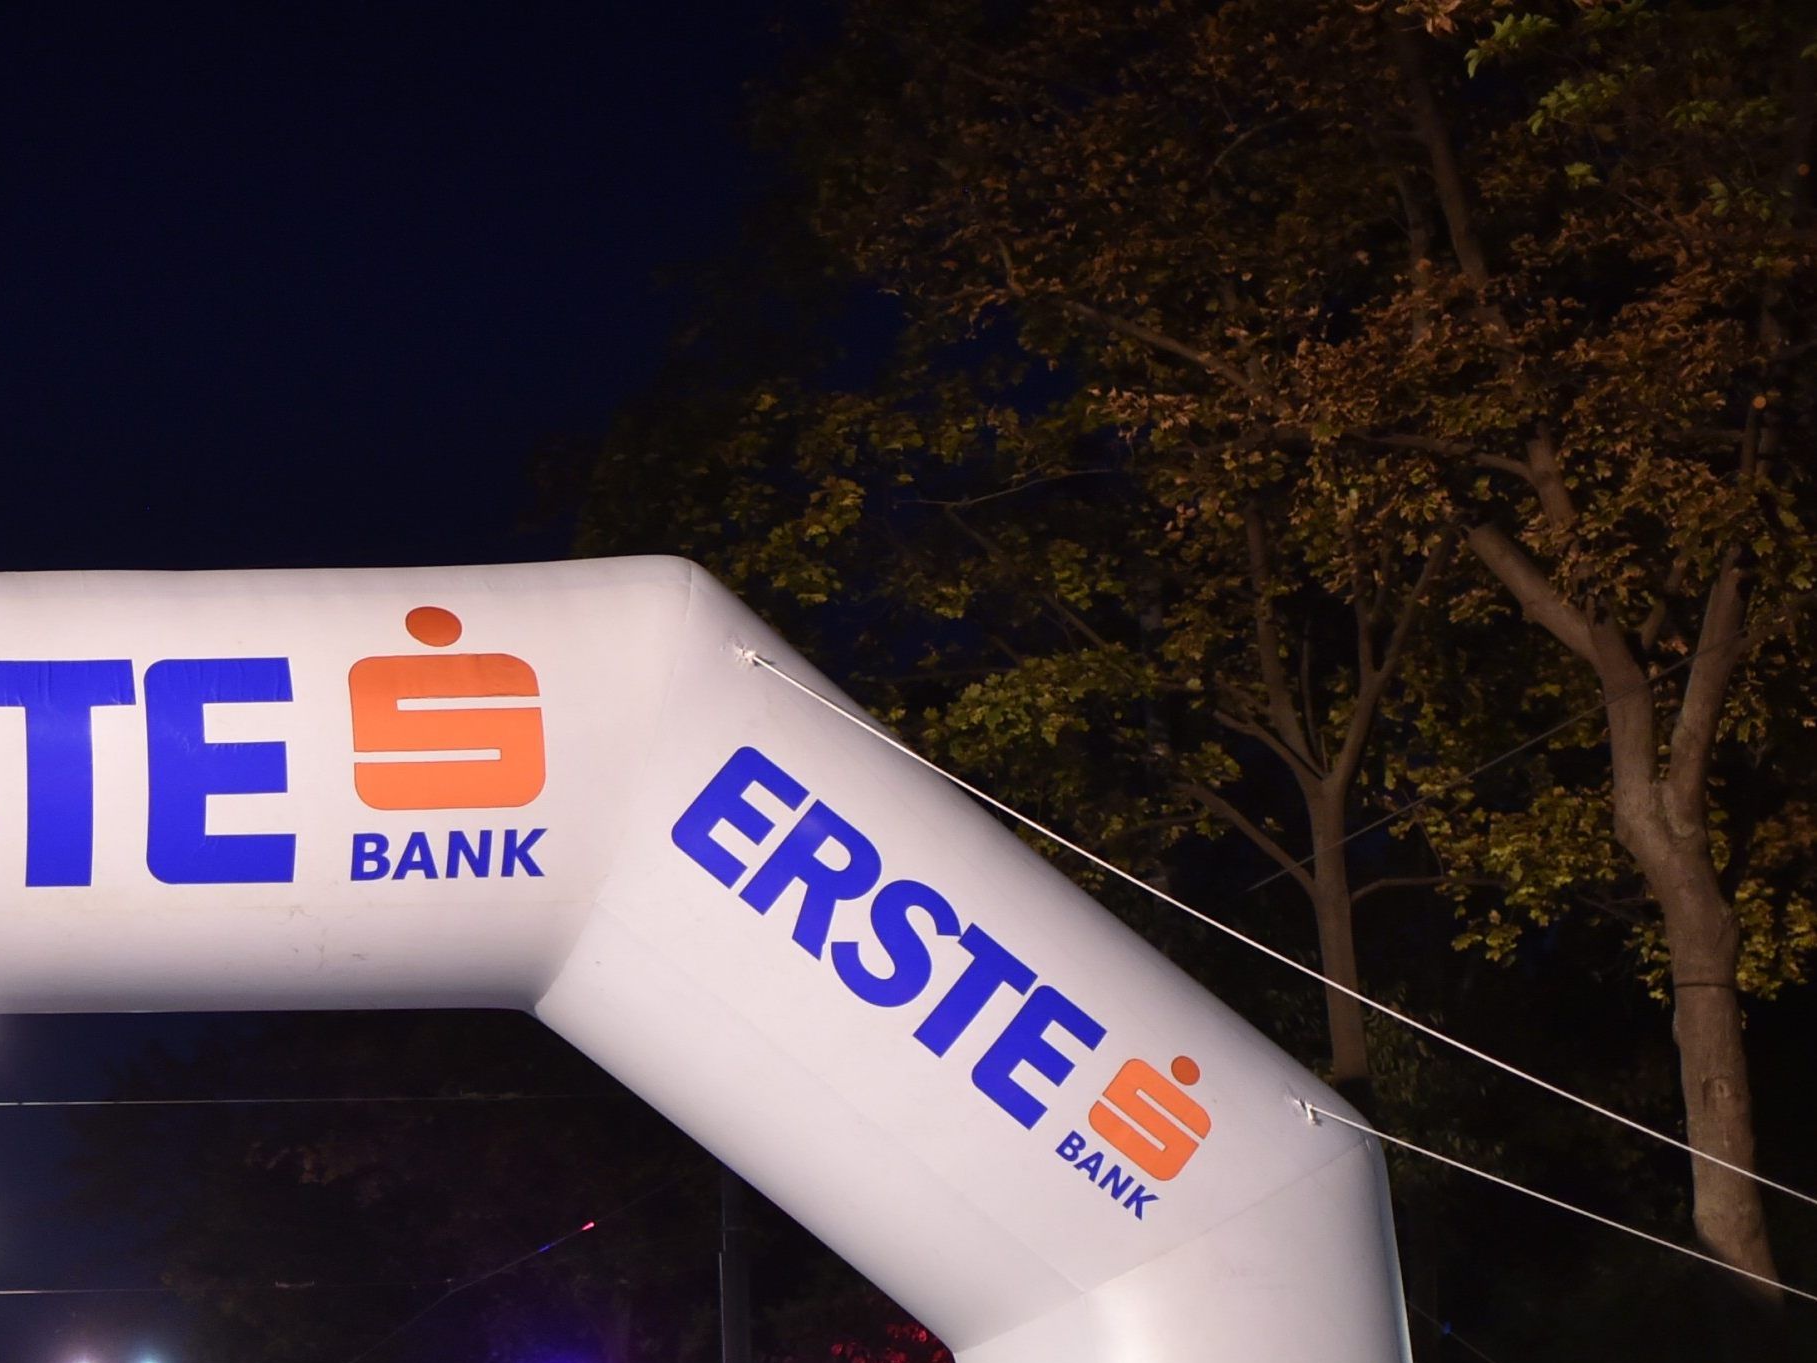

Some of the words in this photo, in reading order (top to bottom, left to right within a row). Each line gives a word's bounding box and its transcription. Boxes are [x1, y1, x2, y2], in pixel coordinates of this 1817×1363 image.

[350, 827, 545, 881] BANK
[671, 746, 1107, 1130] ERSTE
[1055, 1130, 1160, 1220] BANK
